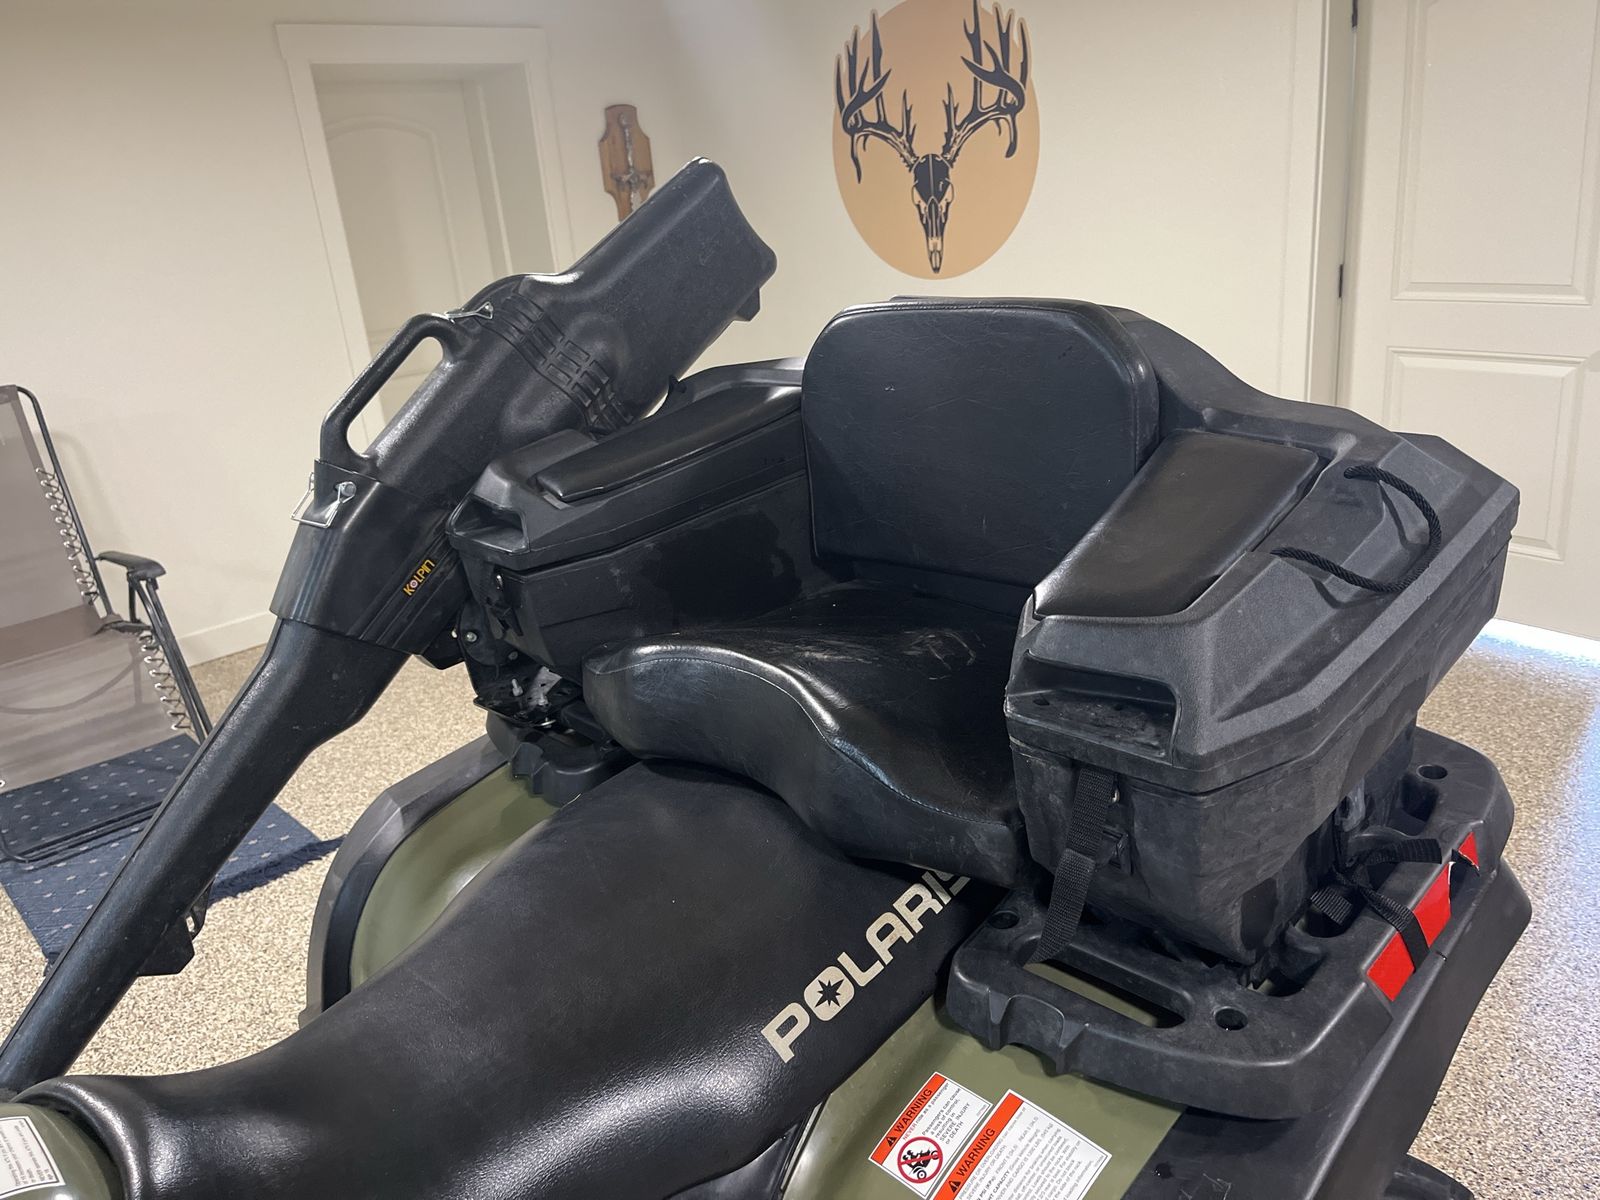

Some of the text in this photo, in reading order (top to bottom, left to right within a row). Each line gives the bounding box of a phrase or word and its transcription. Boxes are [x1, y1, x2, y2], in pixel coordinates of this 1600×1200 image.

[403, 559, 435, 596] KOLPIN
[893, 1087, 933, 1134] WARNING
[902, 1122, 917, 1140] NEVER
[914, 1113, 924, 1123] ride
[929, 1081, 950, 1105] passenger
[921, 1087, 960, 1136] Passengers can cause
[932, 1119, 942, 1131] loss
[944, 1097, 960, 1116] control,
[934, 1117, 952, 1138] resulting
[939, 1101, 970, 1141] SEVERE INJURY
[948, 1120, 964, 1138] DEATH
[955, 1126, 996, 1178] WARNING
[957, 1174, 977, 1199] PRESSURE
[974, 1167, 982, 1176] OR
[979, 1137, 1003, 1168] OVERLOADING
[978, 1188, 987, 1197] PSI
[994, 1158, 1008, 1174] FRONT
[1017, 1129, 1028, 1142] REAR
[1012, 1175, 1027, 1193] distance
[1028, 1153, 1042, 1170] braking
[1039, 1143, 1049, 1154] when
[1038, 1146, 1055, 1167] unsecured
[965, 1181, 980, 1200] SEVERE
[978, 1165, 992, 1182] INJURY
[989, 1158, 997, 1166] OR
[992, 1169, 1011, 1193] CAPACITY
[1004, 1177, 1014, 1188] AND
[1011, 1160, 1025, 1178] CARGO
[1030, 1174, 1042, 1188] Loads
[1039, 1160, 1052, 1175] should
